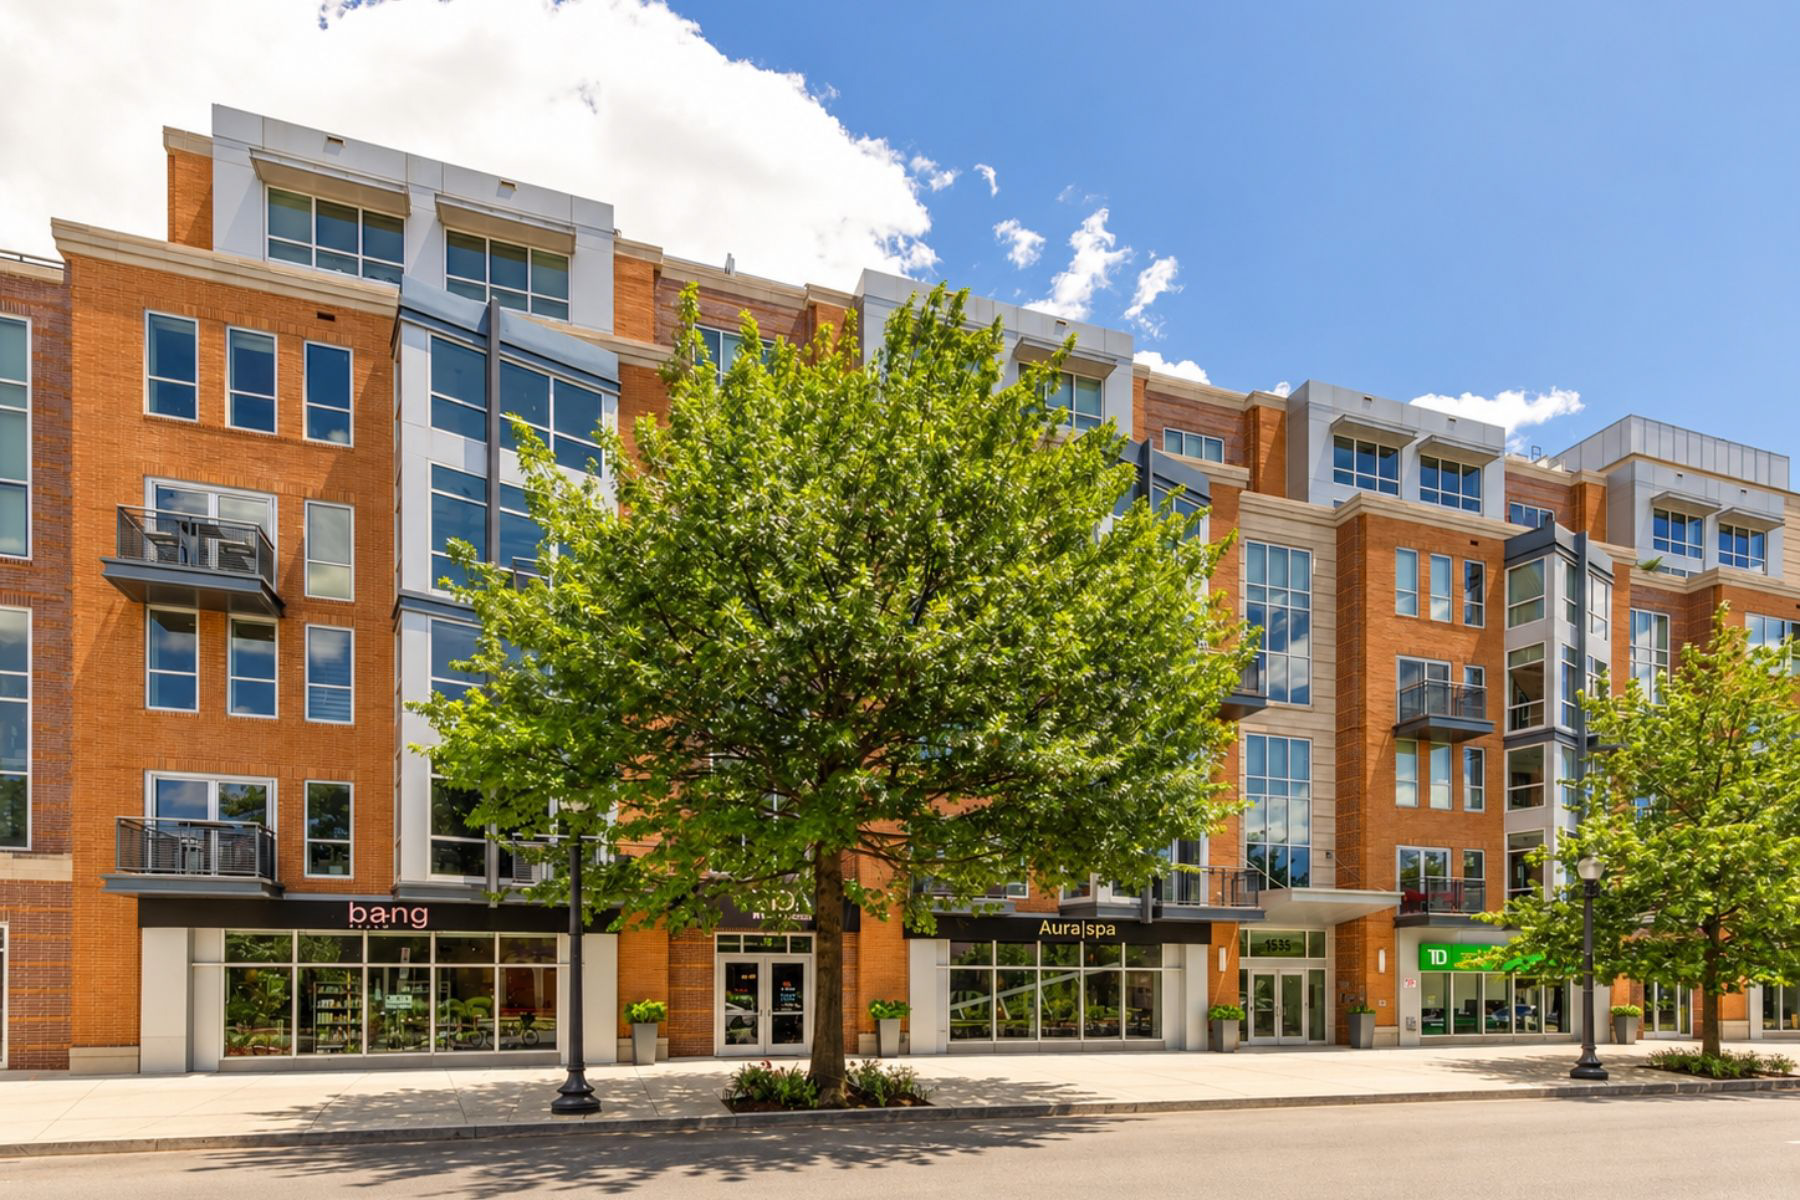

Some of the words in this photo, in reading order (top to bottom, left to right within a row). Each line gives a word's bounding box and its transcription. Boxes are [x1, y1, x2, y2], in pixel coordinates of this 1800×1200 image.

[349, 901, 429, 929] bang
[1264, 939, 1292, 952] 1535
[1427, 949, 1448, 965] TD
